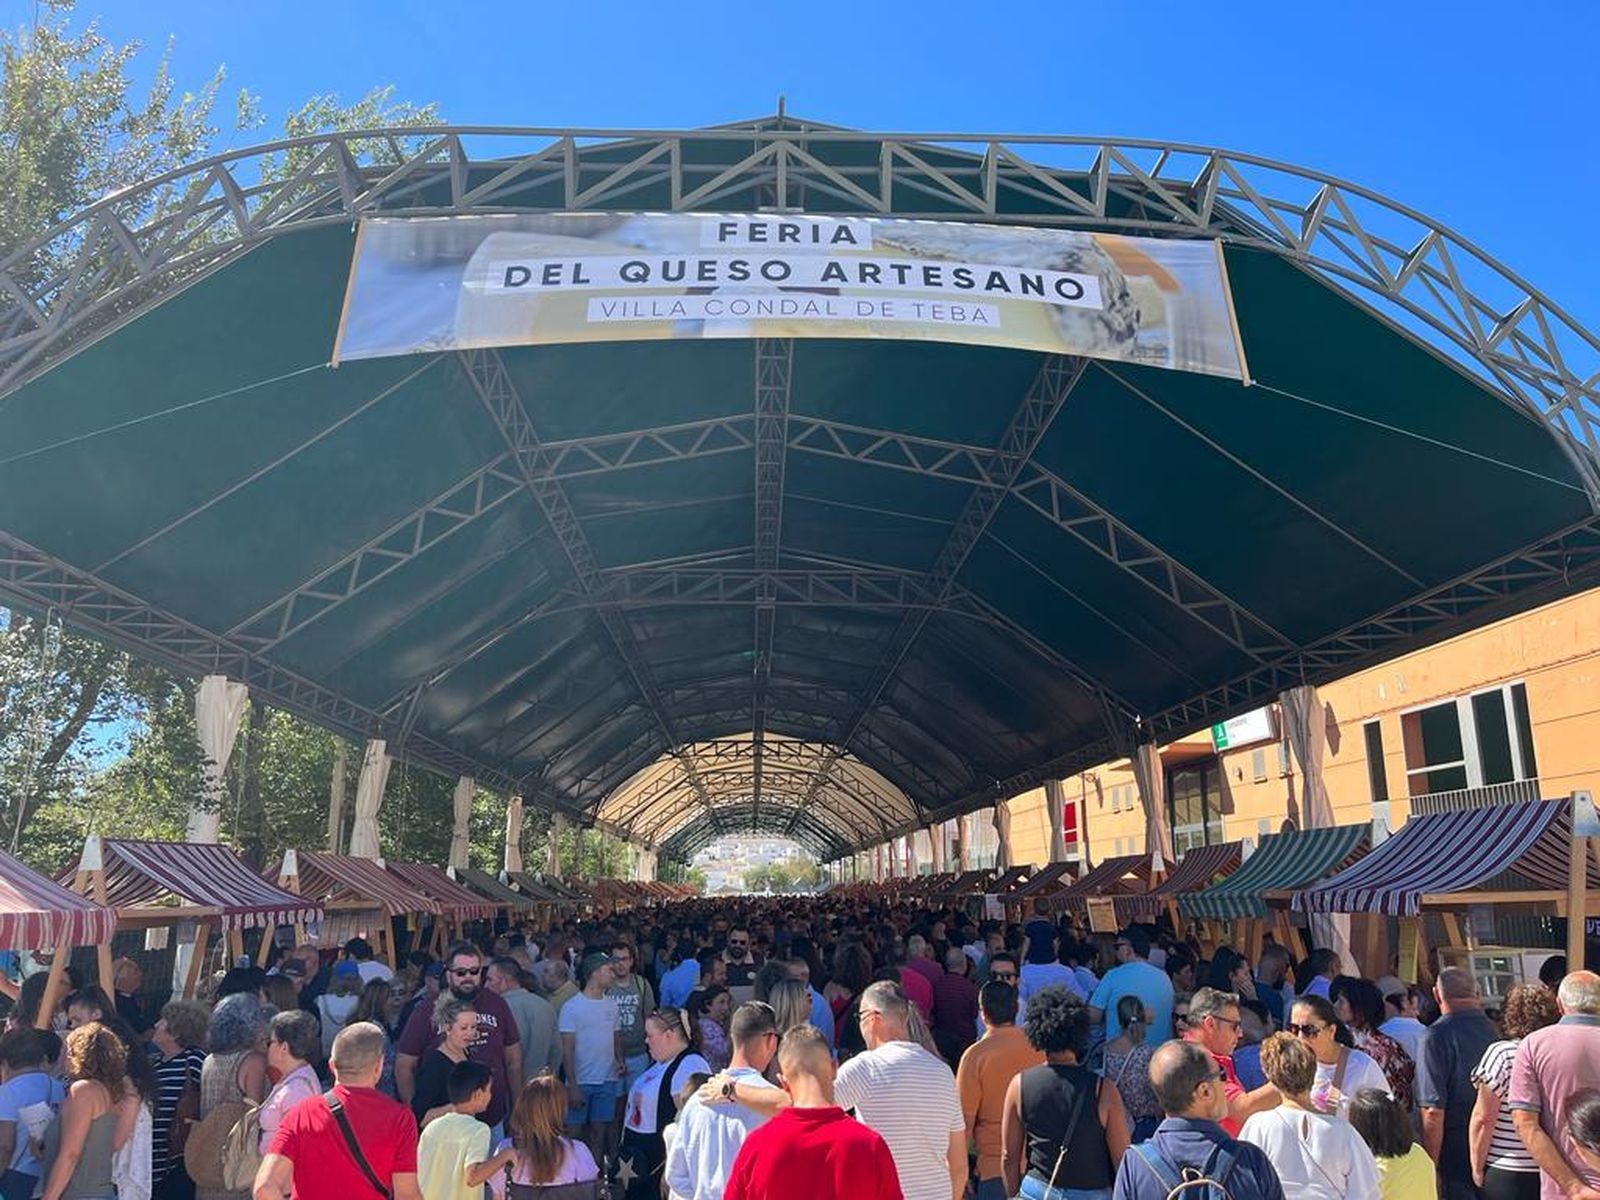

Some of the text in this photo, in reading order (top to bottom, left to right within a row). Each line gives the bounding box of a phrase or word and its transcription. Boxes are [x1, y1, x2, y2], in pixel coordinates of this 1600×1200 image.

[718, 223, 858, 244] FERIA
[503, 260, 1085, 301] DEL QUESO ARTESANO
[601, 299, 988, 323] VILLA CONDAL DE TEBA
